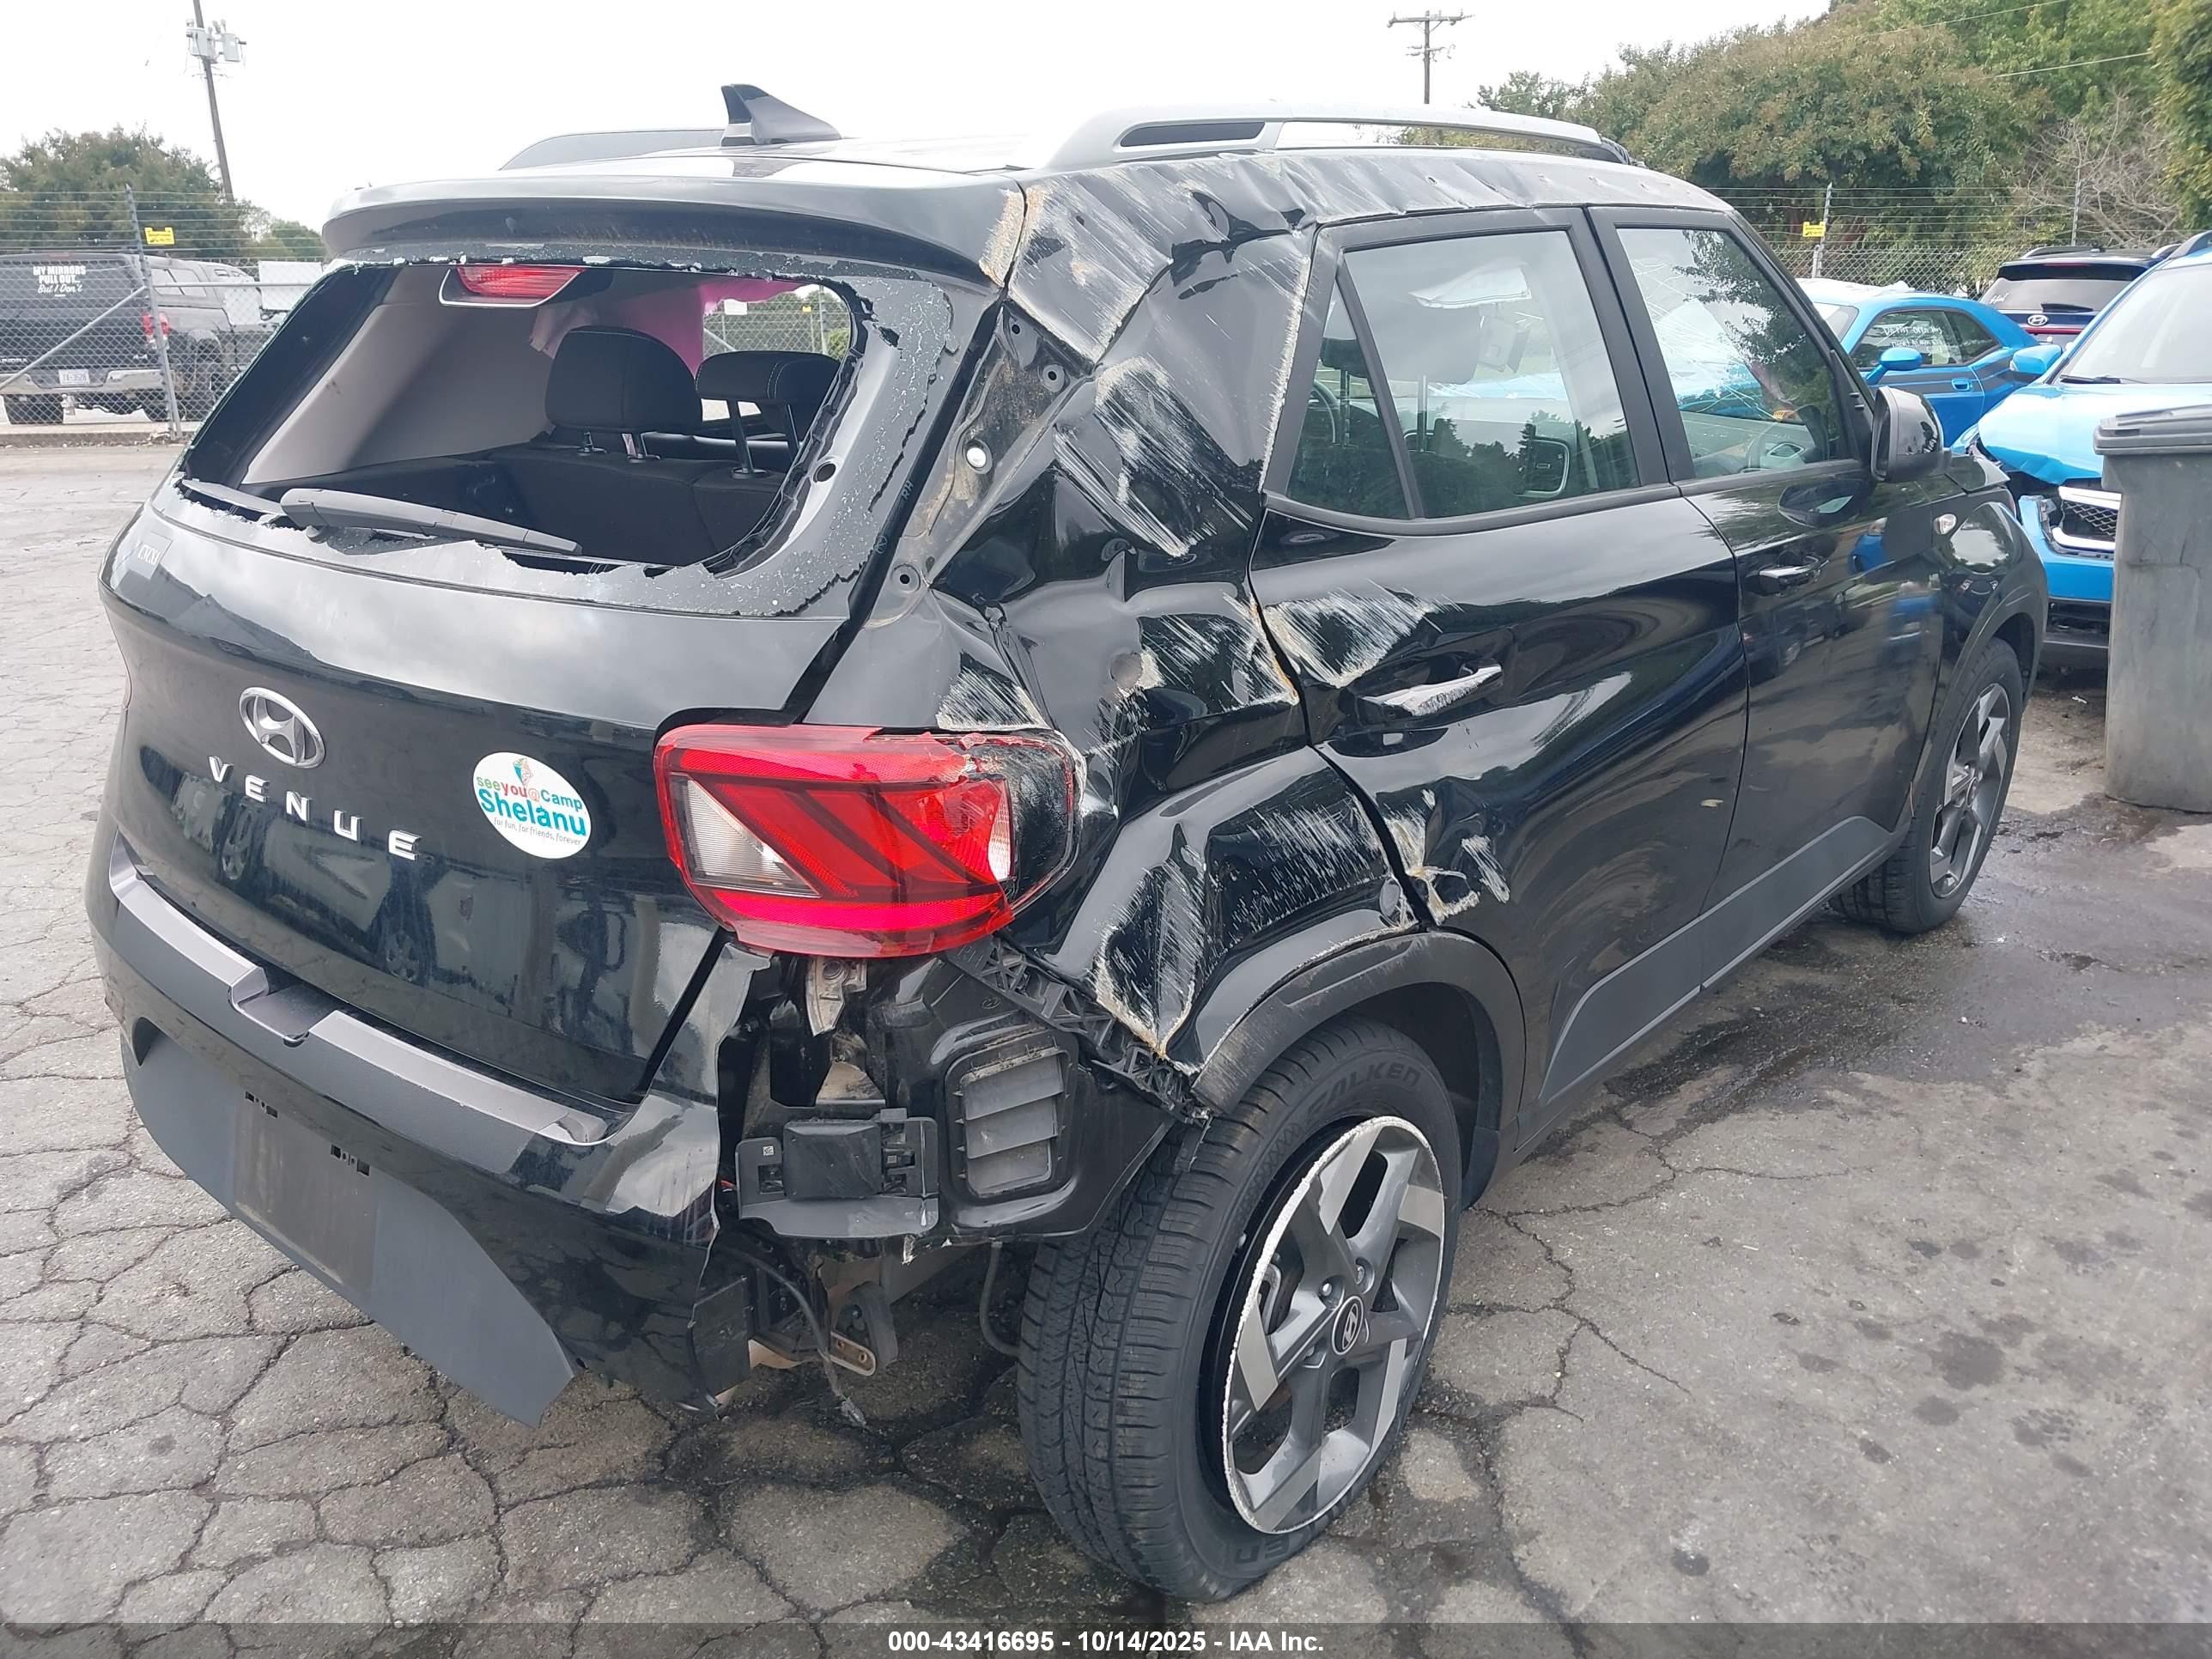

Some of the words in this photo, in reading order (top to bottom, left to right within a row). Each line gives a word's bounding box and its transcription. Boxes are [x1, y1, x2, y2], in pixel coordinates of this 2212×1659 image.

[33, 265, 46, 275] MY
[47, 265, 86, 275] MIRRORS
[39, 275, 58, 283] PULL
[38, 284, 53, 293] But
[208, 756, 422, 860] VENUE
[478, 788, 586, 836] Shelanu
[556, 833, 581, 846] forever
